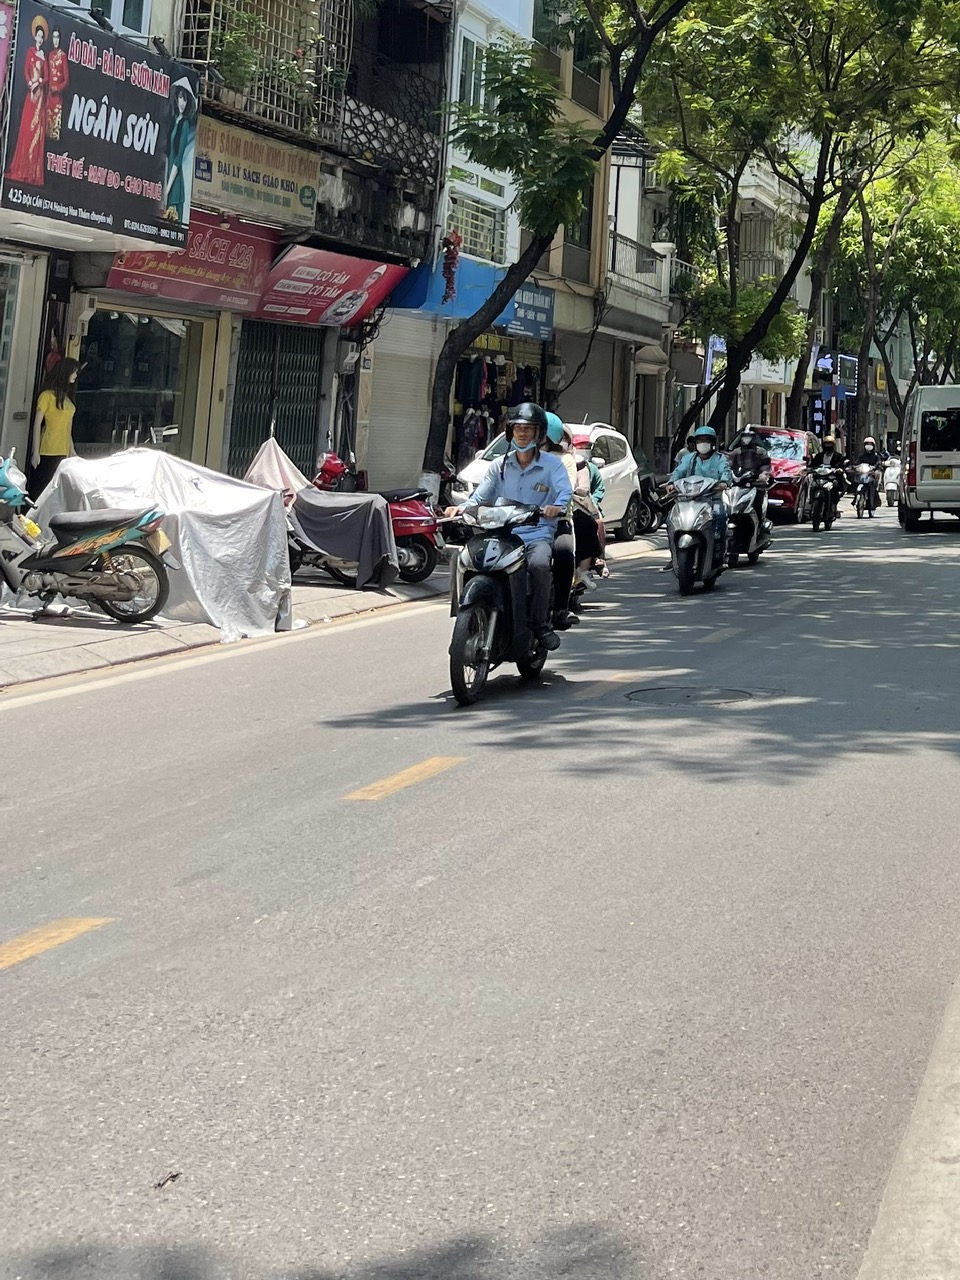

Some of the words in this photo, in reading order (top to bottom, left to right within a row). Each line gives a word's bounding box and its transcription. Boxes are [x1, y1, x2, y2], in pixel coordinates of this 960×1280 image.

[68, 32, 81, 64] ÁO
[81, 39, 98, 70] DÀI
[102, 47, 114, 77] BÀ
[114, 54, 126, 82] BA
[68, 93, 123, 144] NGÂN
[122, 111, 160, 156] SƠN
[220, 130, 242, 157] SÁCH
[46, 151, 72, 177] THIẾT
[72, 156, 85, 180] KẾ
[88, 164, 107, 186] MAY
[124, 175, 142, 196] CHO
[142, 181, 163, 202] THUÊ
[217, 160, 231, 178] ĐẠI
[232, 162, 242, 179] LÝ
[243, 165, 261, 184] SÁCH
[262, 172, 280, 190] GIÁO
[8, 187, 23, 204] 425
[189, 229, 231, 265] SÁCH
[228, 242, 255, 269] 423
